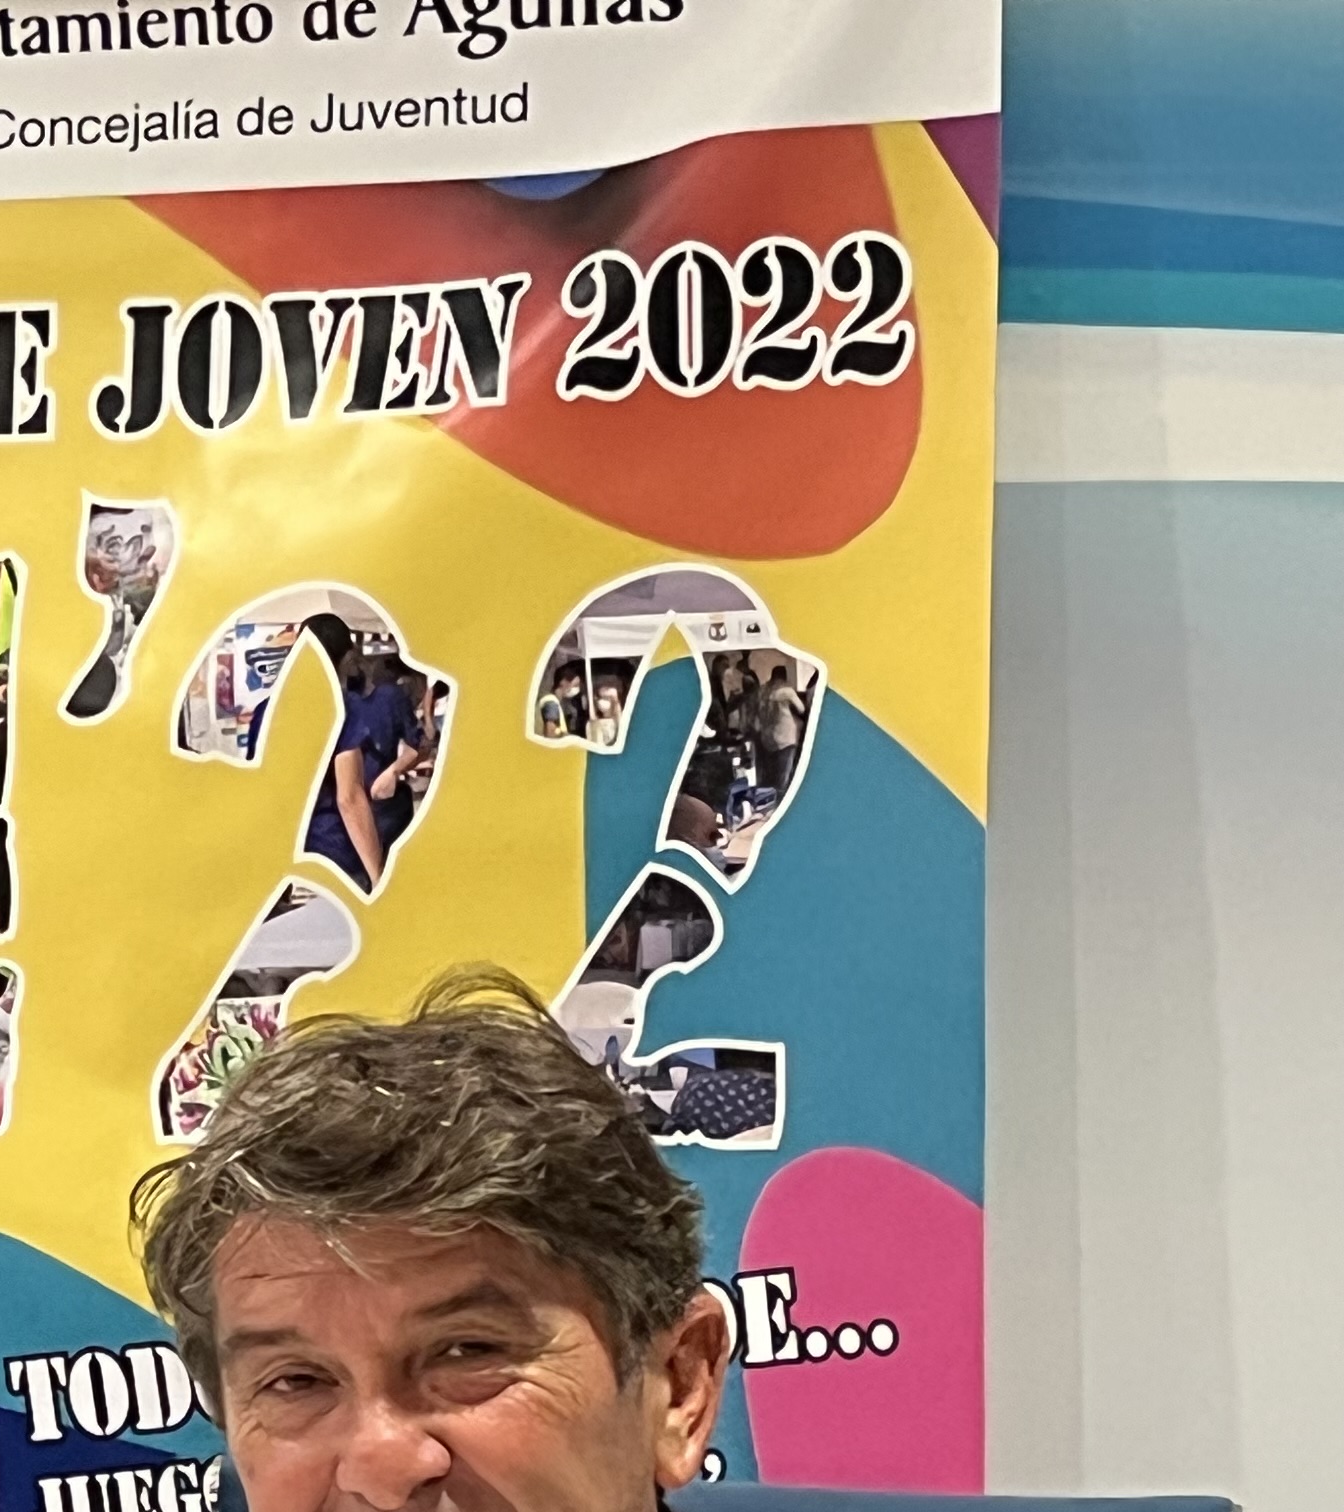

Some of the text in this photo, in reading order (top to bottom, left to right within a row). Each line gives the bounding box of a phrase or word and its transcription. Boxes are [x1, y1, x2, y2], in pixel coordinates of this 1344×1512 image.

[236, 96, 296, 138] de
[310, 82, 531, 135] Juventud
[94, 269, 532, 438] JOVEN
[558, 230, 913, 402] 2022
[4, 1341, 219, 1443] TOD
